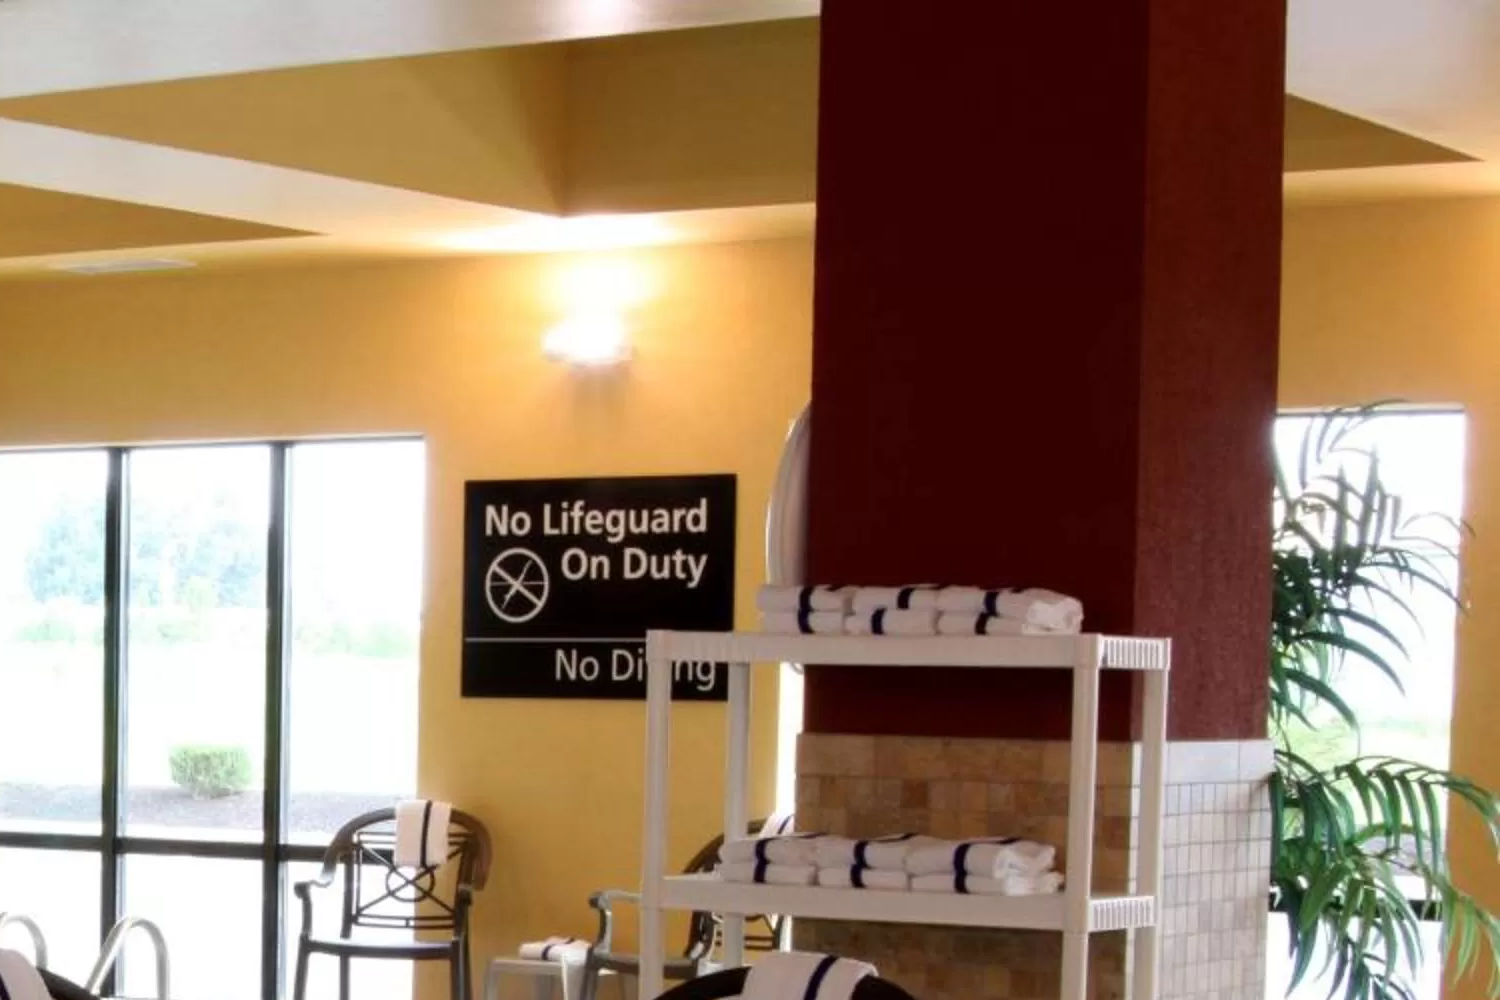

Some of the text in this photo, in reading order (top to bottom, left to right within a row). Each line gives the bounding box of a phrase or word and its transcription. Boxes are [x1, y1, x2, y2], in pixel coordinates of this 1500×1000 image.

[484, 497, 709, 544] No Lifeguard
[560, 547, 709, 589] On Duty
[554, 648, 717, 692] No Ding
